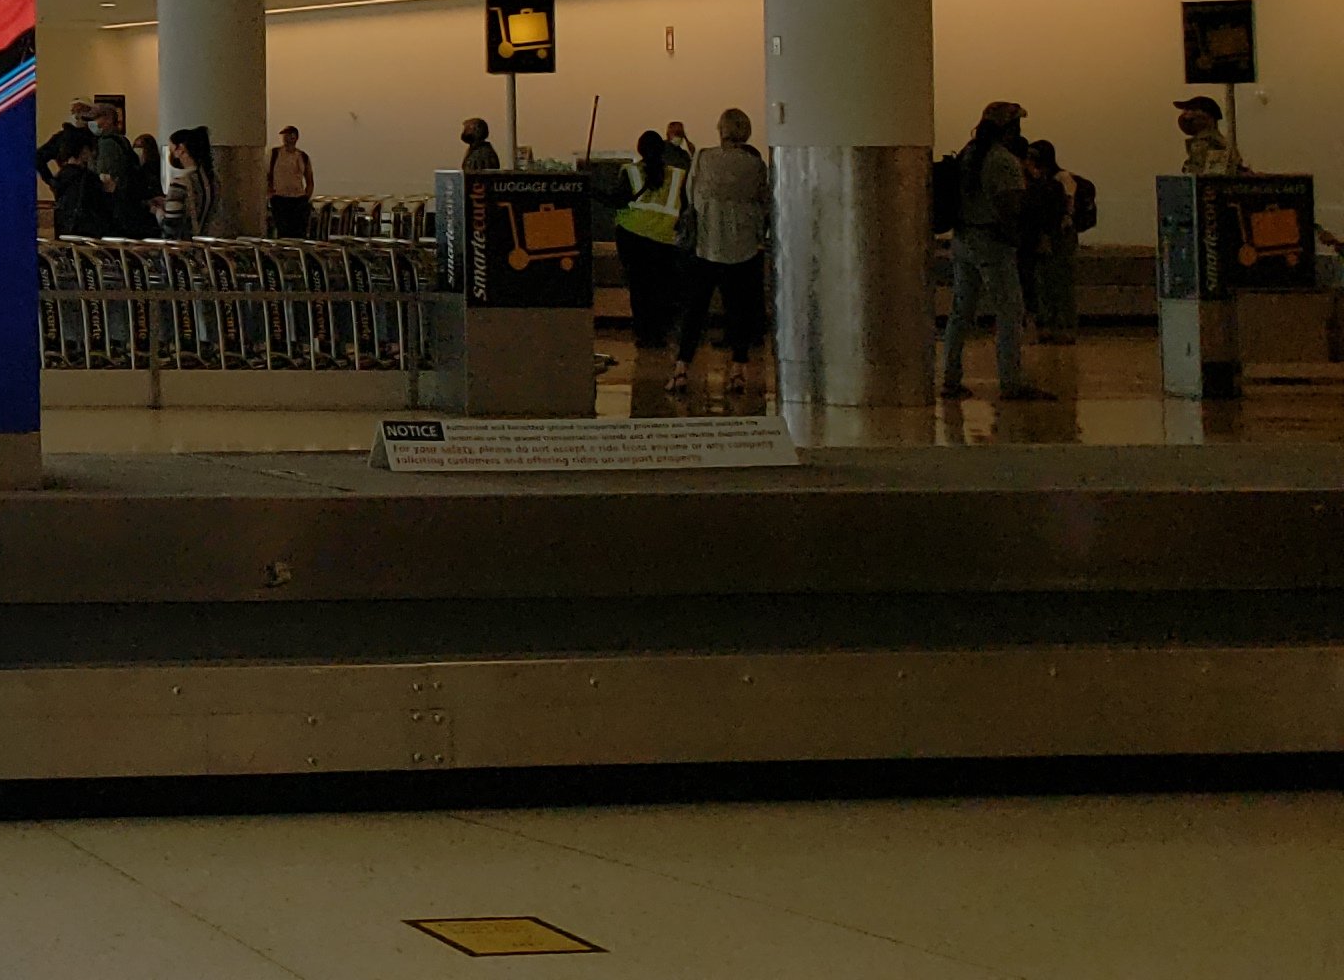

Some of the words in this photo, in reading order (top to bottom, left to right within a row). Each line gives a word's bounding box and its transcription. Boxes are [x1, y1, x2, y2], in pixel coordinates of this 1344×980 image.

[493, 181, 547, 193] LUGGAGE
[550, 182, 584, 193] CARTS
[386, 424, 439, 437] NOTICE
